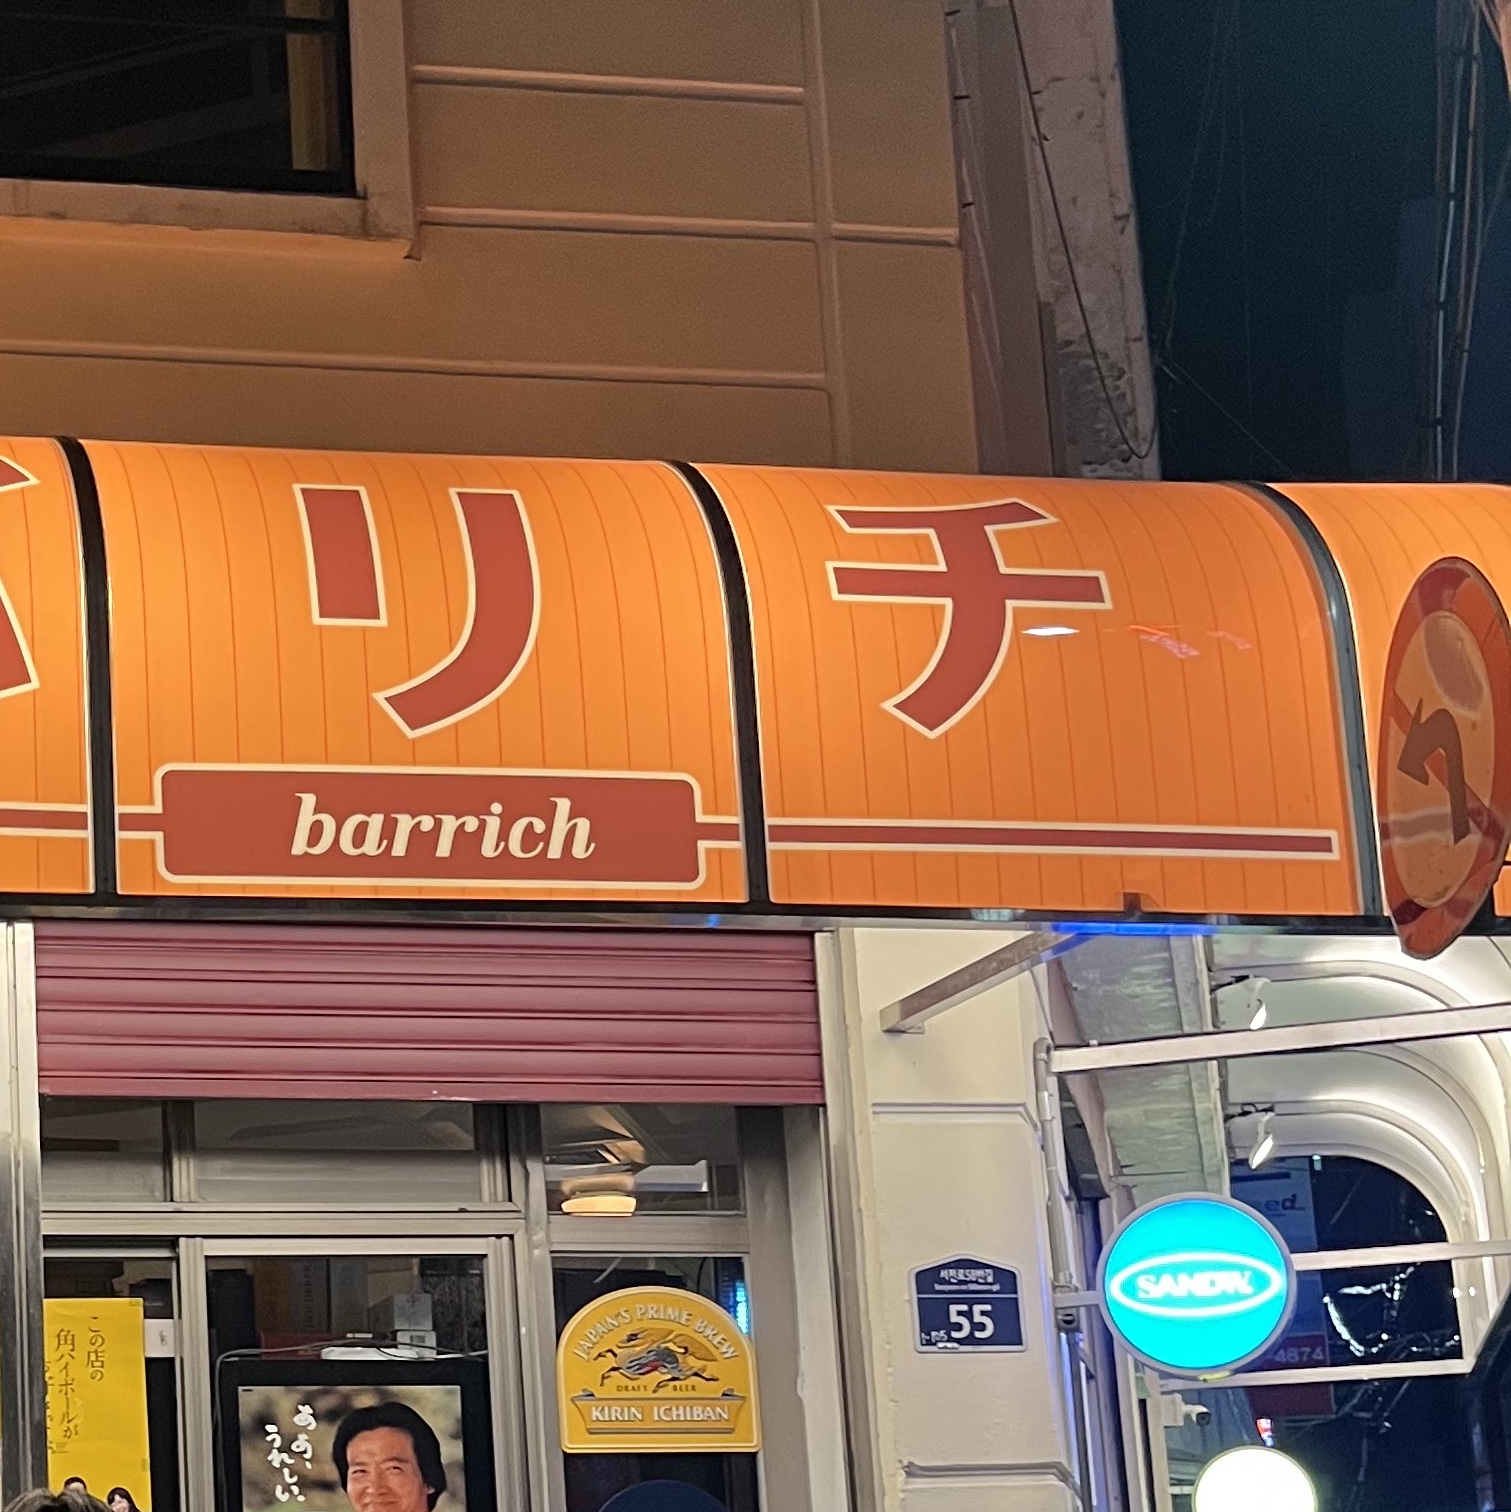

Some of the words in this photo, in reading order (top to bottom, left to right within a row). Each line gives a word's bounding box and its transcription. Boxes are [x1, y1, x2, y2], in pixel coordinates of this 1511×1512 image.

[290, 792, 596, 861] barrich
[86, 1315, 106, 1382] この店の
[572, 1309, 631, 1361] JAPAN'S
[635, 1303, 692, 1327] PRIME
[695, 1316, 738, 1361] BREW
[948, 1303, 995, 1339] 55
[54, 1328, 79, 1439] 角ハイボールが
[616, 1384, 648, 1392] DRAFT
[672, 1384, 697, 1392] BEER
[591, 1406, 644, 1422] KIRIN
[653, 1405, 729, 1422] ICHIBAN
